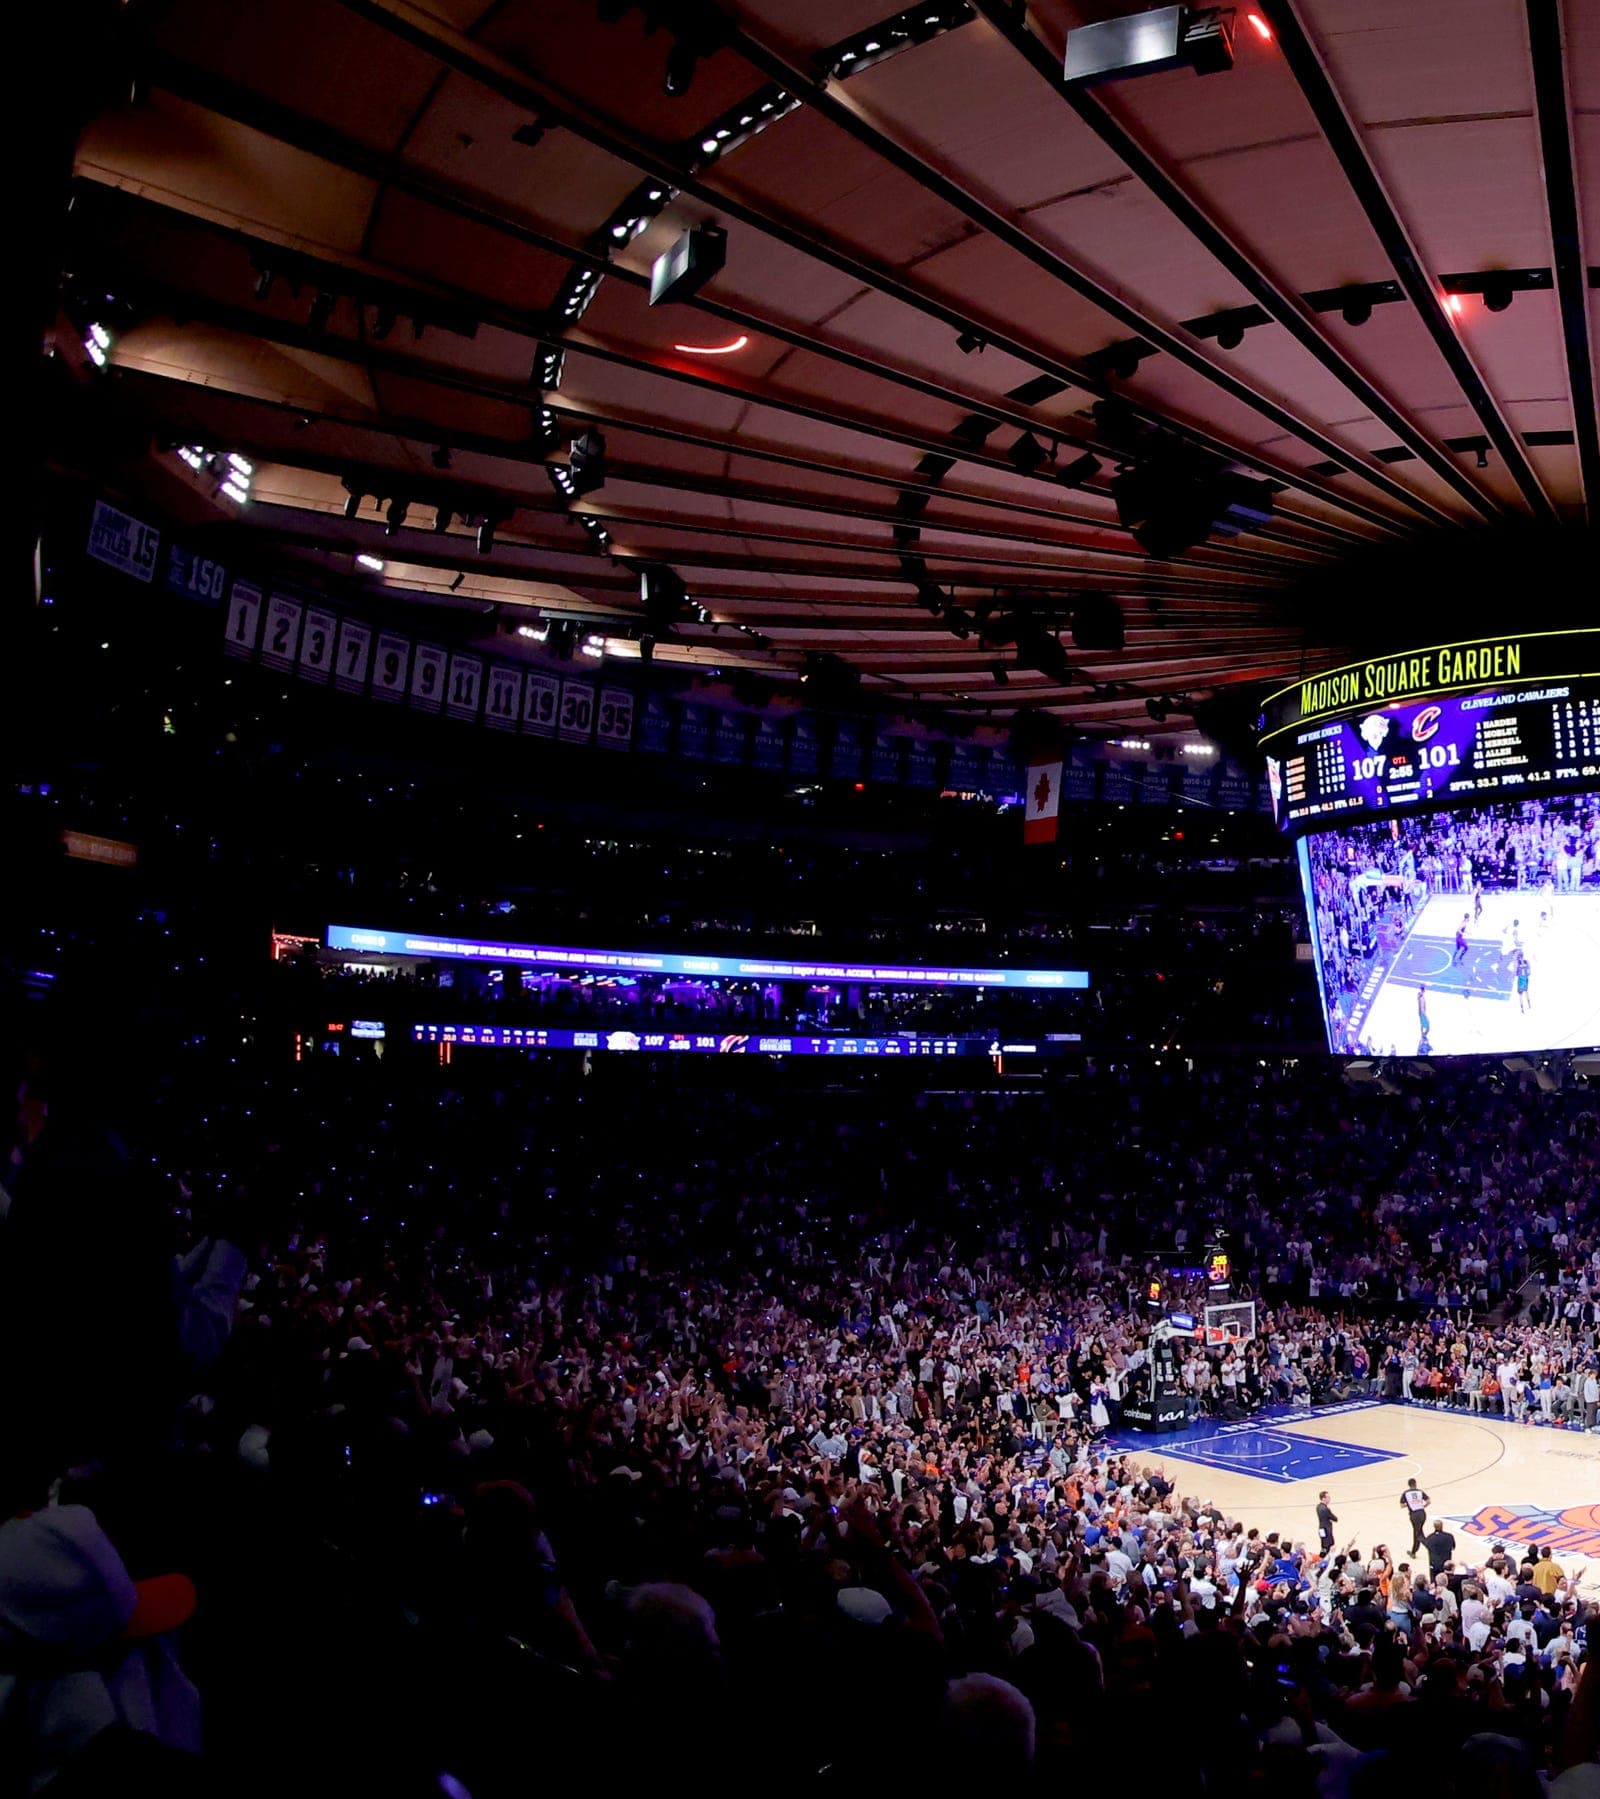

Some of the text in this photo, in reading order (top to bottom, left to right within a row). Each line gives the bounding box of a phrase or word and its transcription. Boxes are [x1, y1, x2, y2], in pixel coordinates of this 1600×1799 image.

[188, 555, 226, 600] 150
[235, 605, 247, 642] 1
[273, 618, 290, 653] 2
[309, 630, 325, 664] 3
[347, 641, 361, 675] 7
[383, 653, 399, 685] 9
[421, 663, 436, 694] 9
[1300, 644, 1520, 715] MADISON SQUARE GARDEN
[454, 672, 474, 705] 11
[491, 683, 513, 715] 11
[1461, 687, 1569, 710] CLEVELAND CAVALIERS
[528, 690, 555, 721] 19
[562, 697, 590, 729] 30
[600, 704, 631, 735] 35
[1483, 717, 1517, 729] HARDEN
[1352, 743, 1460, 780] 107 101
[1485, 747, 1512, 758] ALLEN
[1389, 765, 1413, 779] 2:55
[1527, 771, 1550, 781] 41.2
[645, 1036, 664, 1046] 107
[697, 1037, 715, 1047] 101
[1123, 1409, 1152, 1421] coinbase
[1264, 1412, 1314, 1424] YORK
[1315, 1400, 1380, 1415] KNICKS
